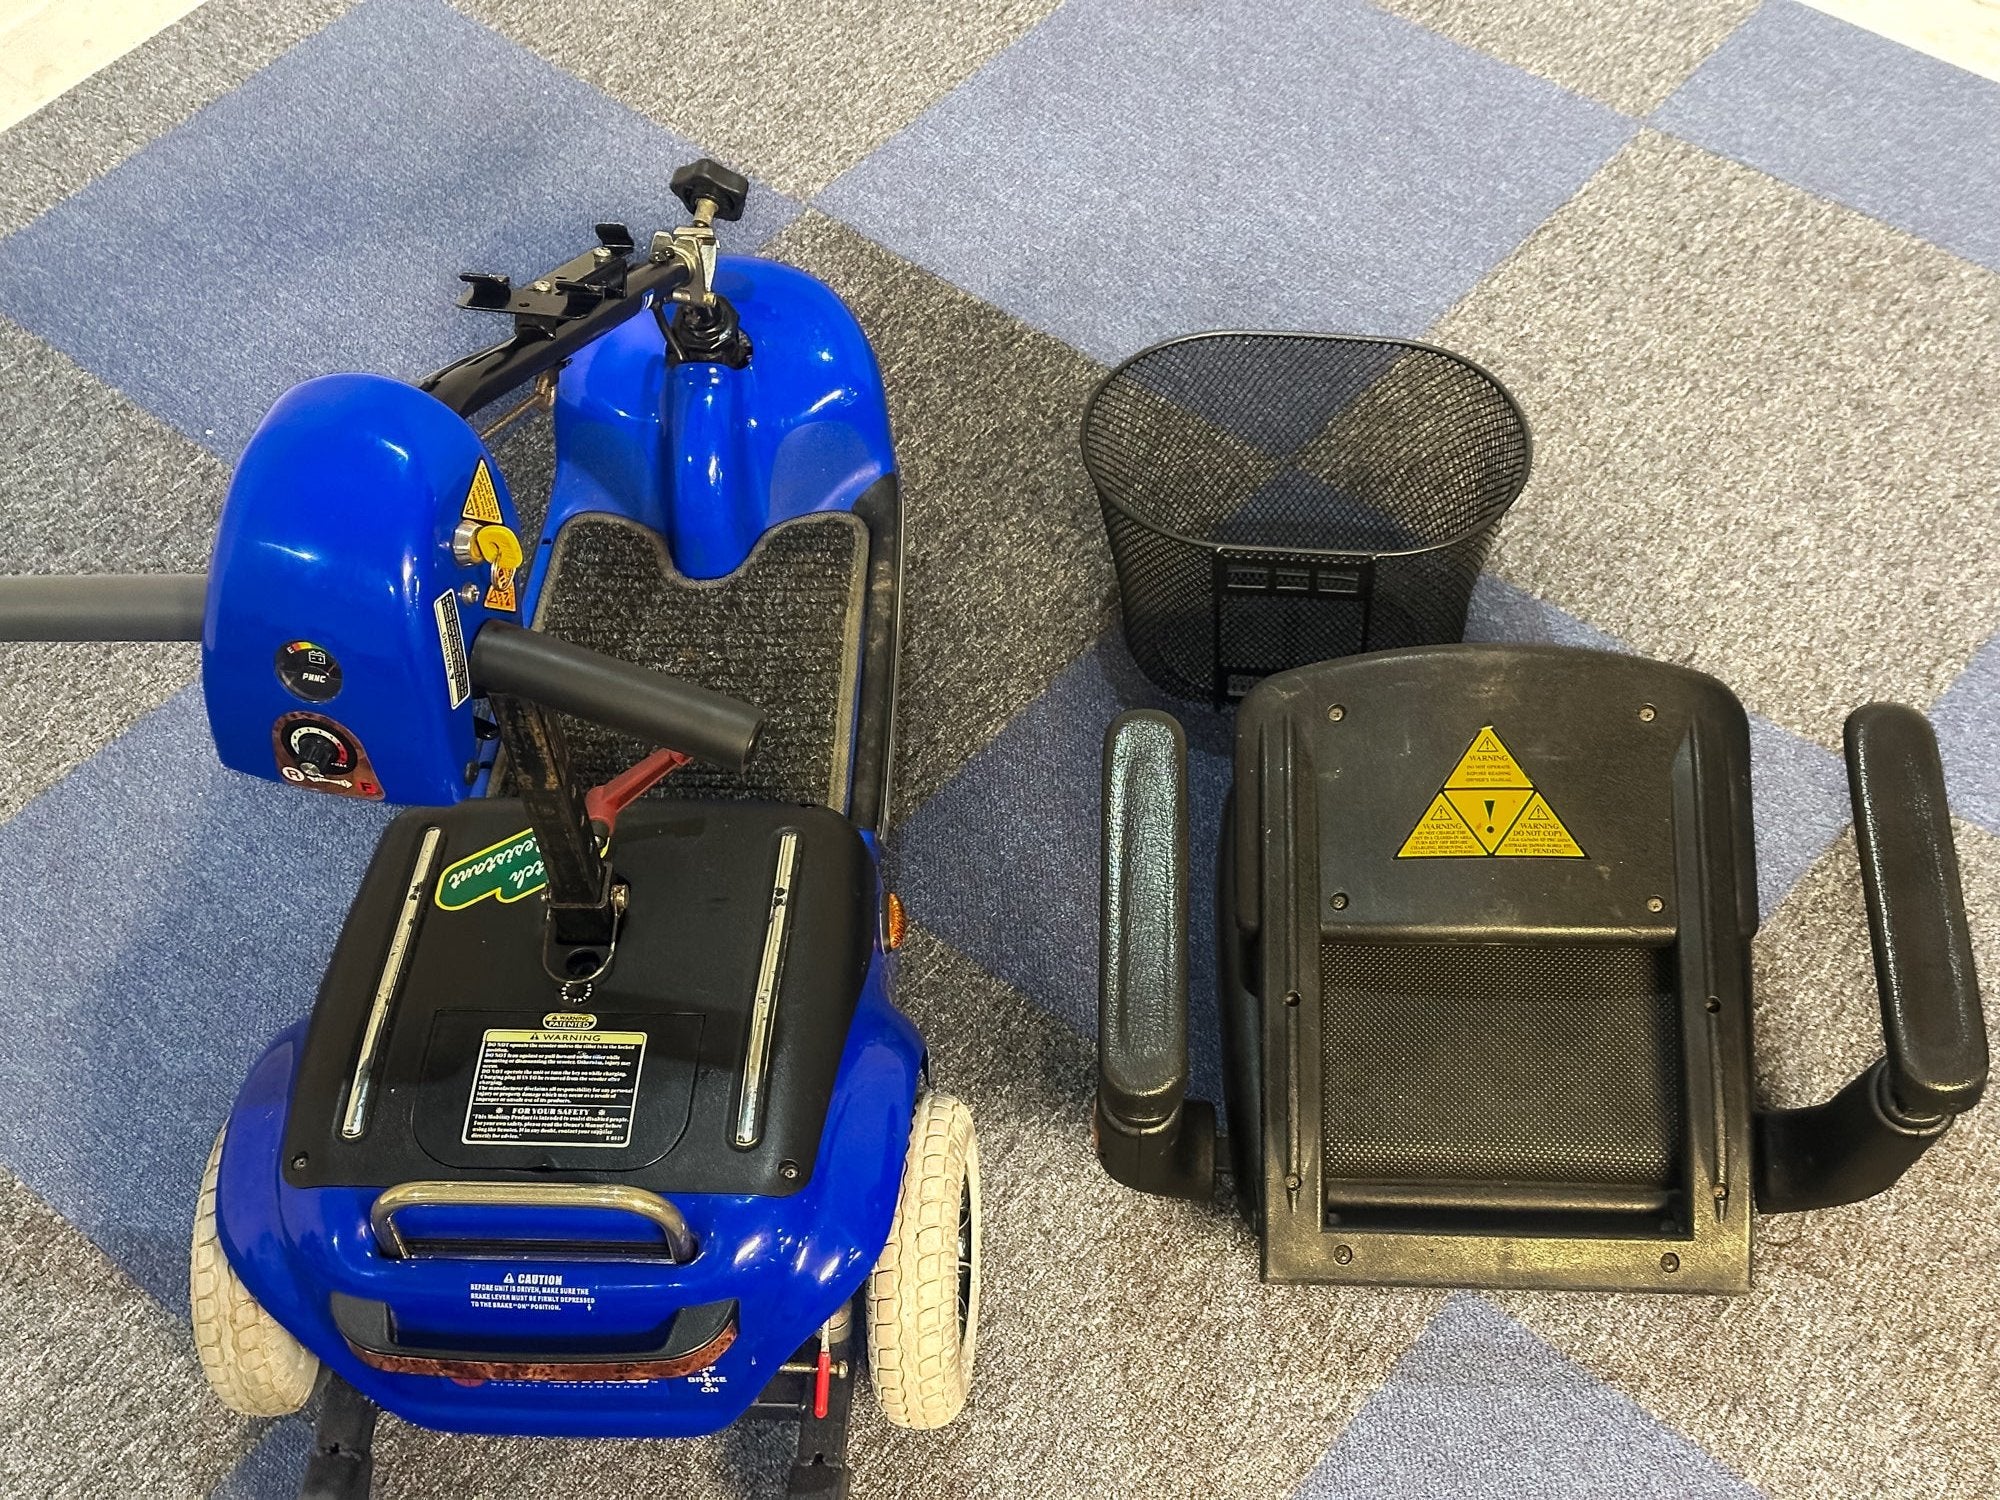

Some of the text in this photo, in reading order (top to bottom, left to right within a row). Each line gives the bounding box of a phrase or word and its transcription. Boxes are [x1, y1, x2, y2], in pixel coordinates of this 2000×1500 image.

[517, 1274, 563, 1285] CAUTION
[516, 1285, 541, 1294] DRIVEN,
[560, 1296, 595, 1304] DEPRESSED
